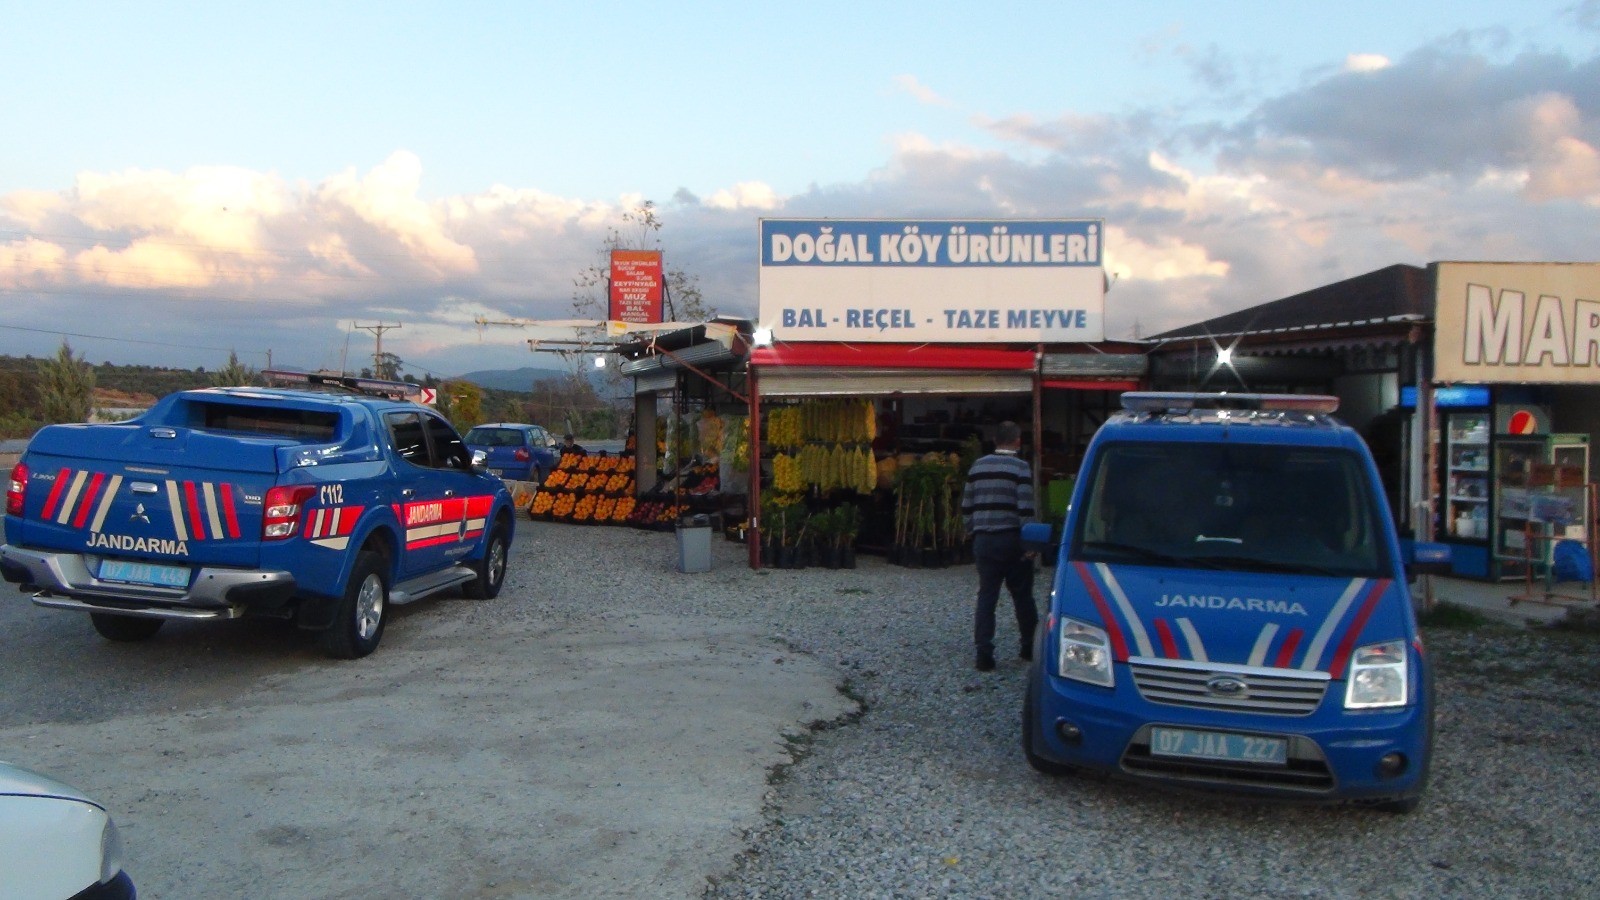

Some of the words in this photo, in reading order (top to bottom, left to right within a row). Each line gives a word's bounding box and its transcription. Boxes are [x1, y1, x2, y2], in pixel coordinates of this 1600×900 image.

[771, 226, 874, 263] DOĞAL
[880, 225, 942, 263] KÖY
[947, 224, 1098, 264] ÜRÜNLERİ
[782, 308, 828, 329] BAL
[846, 308, 916, 333] REÇEL
[943, 309, 1000, 329] TAZE
[1007, 309, 1087, 330] MEYVE
[407, 503, 443, 525] JANDARMA
[86, 532, 189, 556] JANDARMA
[1154, 594, 1308, 616] JANDARMA
[1160, 729, 1184, 752] 07
[1191, 733, 1228, 756] JAA
[1243, 737, 1280, 760] 227
